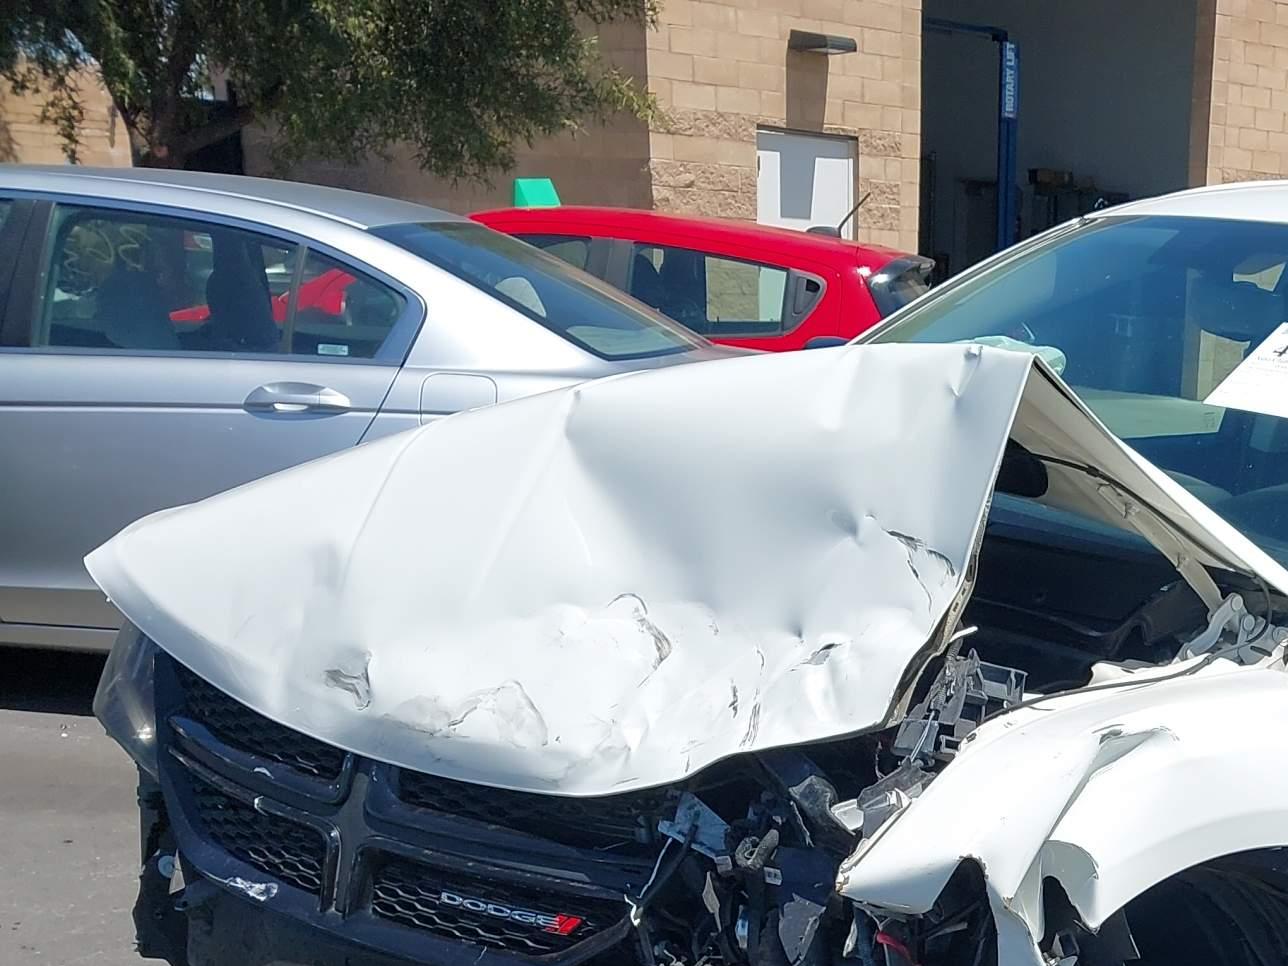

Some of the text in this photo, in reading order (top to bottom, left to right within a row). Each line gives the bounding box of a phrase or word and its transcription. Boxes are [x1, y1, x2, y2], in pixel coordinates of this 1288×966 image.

[1005, 42, 1015, 112] ROTARY LIFT
[440, 891, 560, 929] DODGE
